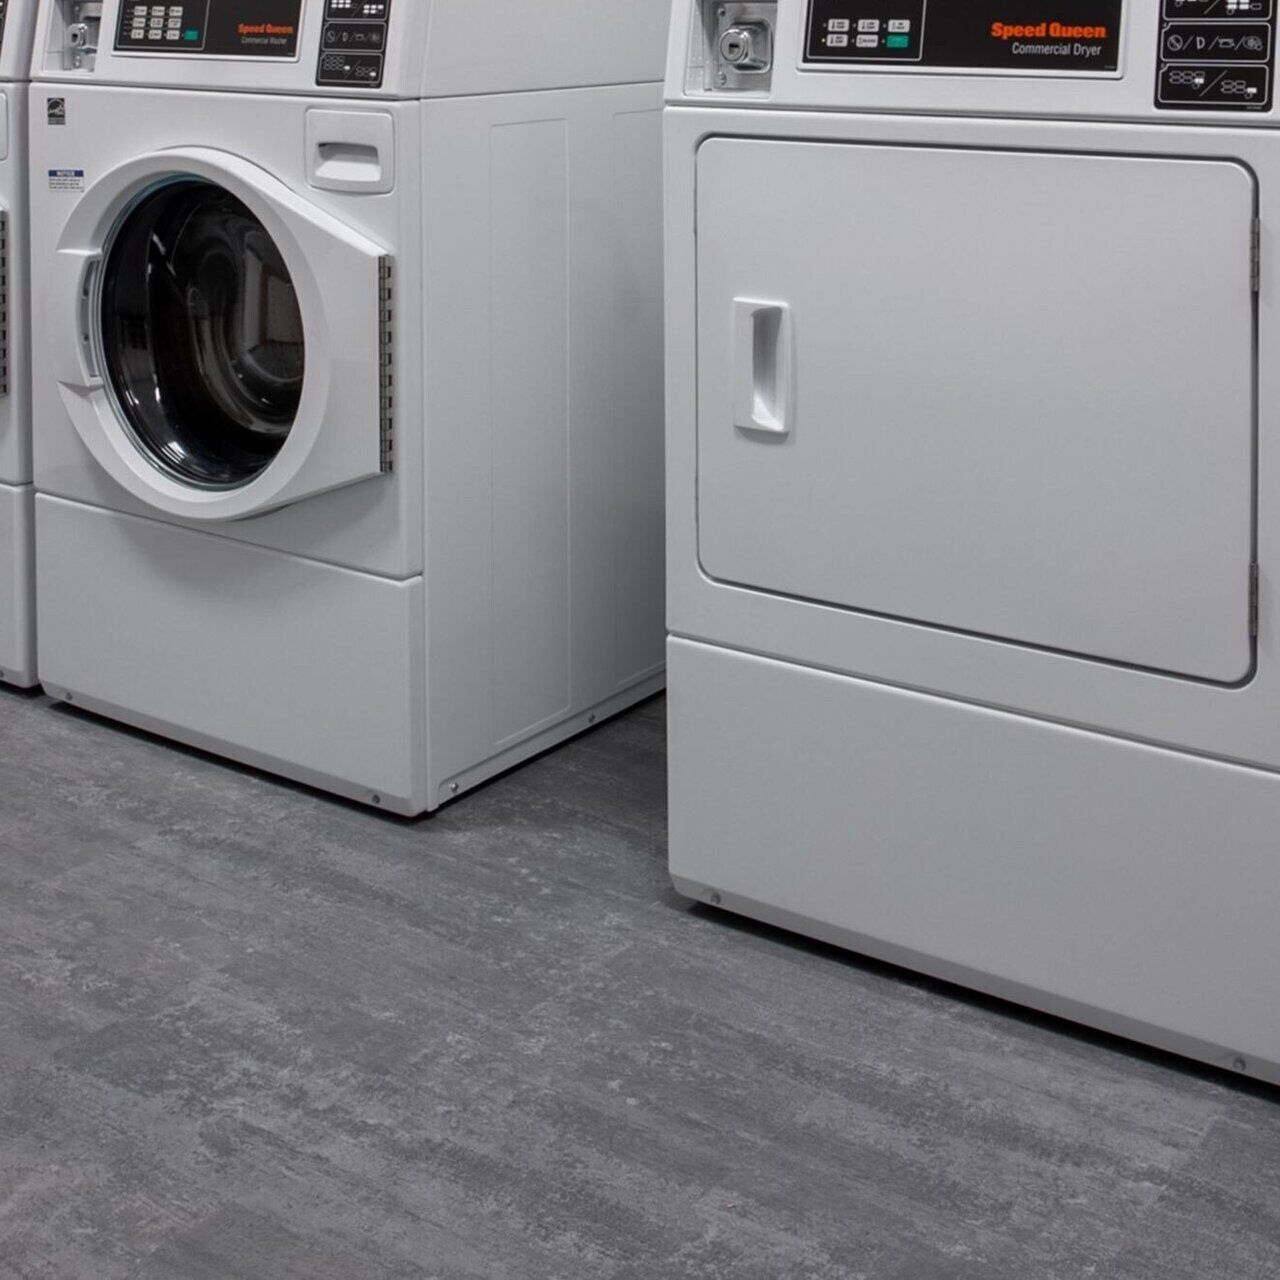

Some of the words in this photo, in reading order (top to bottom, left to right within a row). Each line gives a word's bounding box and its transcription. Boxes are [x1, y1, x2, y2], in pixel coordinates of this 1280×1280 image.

[991, 22, 1047, 40] Speed
[1049, 22, 1107, 38] Queen
[1012, 42, 1071, 56] Commercial
[1073, 43, 1102, 58] Dryer
